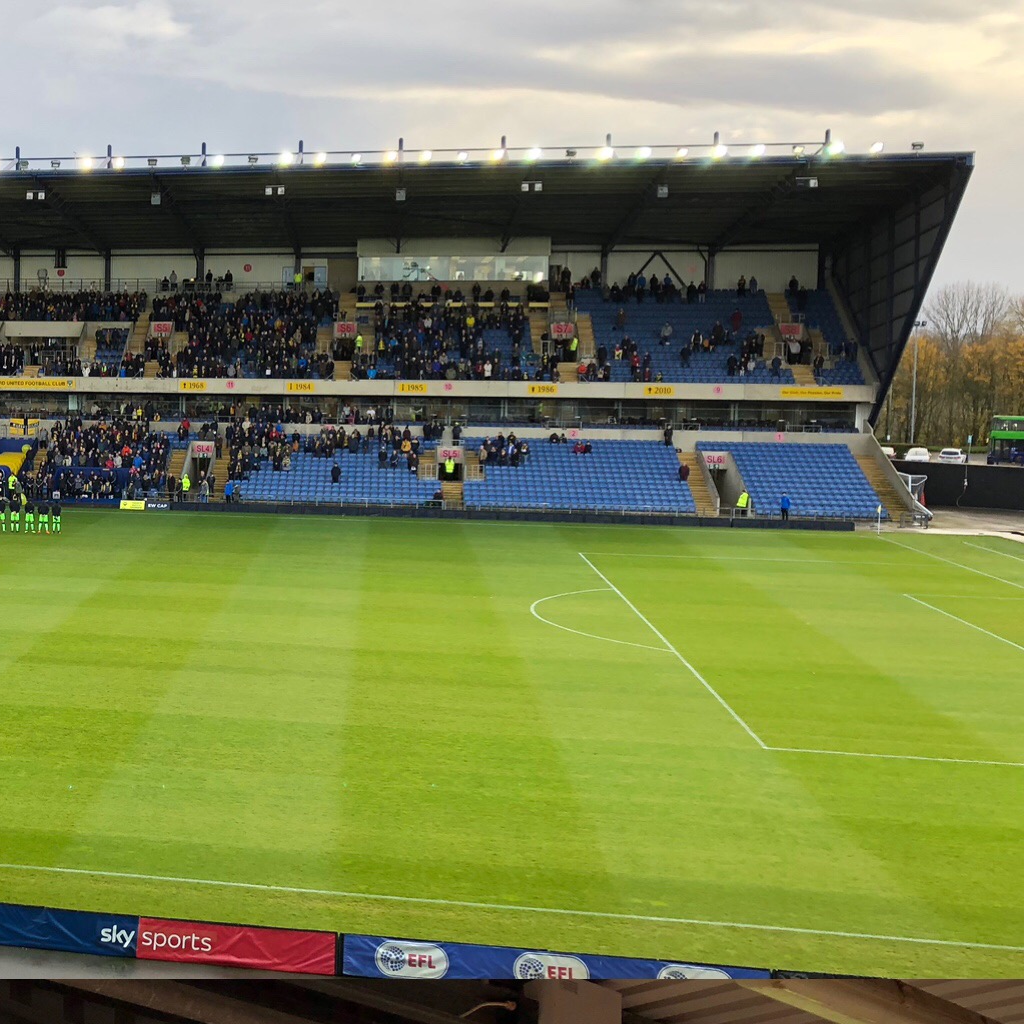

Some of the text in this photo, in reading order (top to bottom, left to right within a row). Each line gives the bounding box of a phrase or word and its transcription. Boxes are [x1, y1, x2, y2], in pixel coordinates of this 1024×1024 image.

[157, 324, 168, 332] S5
[340, 324, 352, 332] S6
[556, 325, 569, 333] S7
[296, 383, 310, 391] 1984
[407, 384, 423, 392] 1985
[654, 386, 672, 394] 2010
[196, 444, 210, 452] SL4
[442, 450, 458, 458] SL5
[706, 456, 722, 464] SL6
[100, 924, 212, 952] sky sports
[407, 953, 436, 970] EFL
